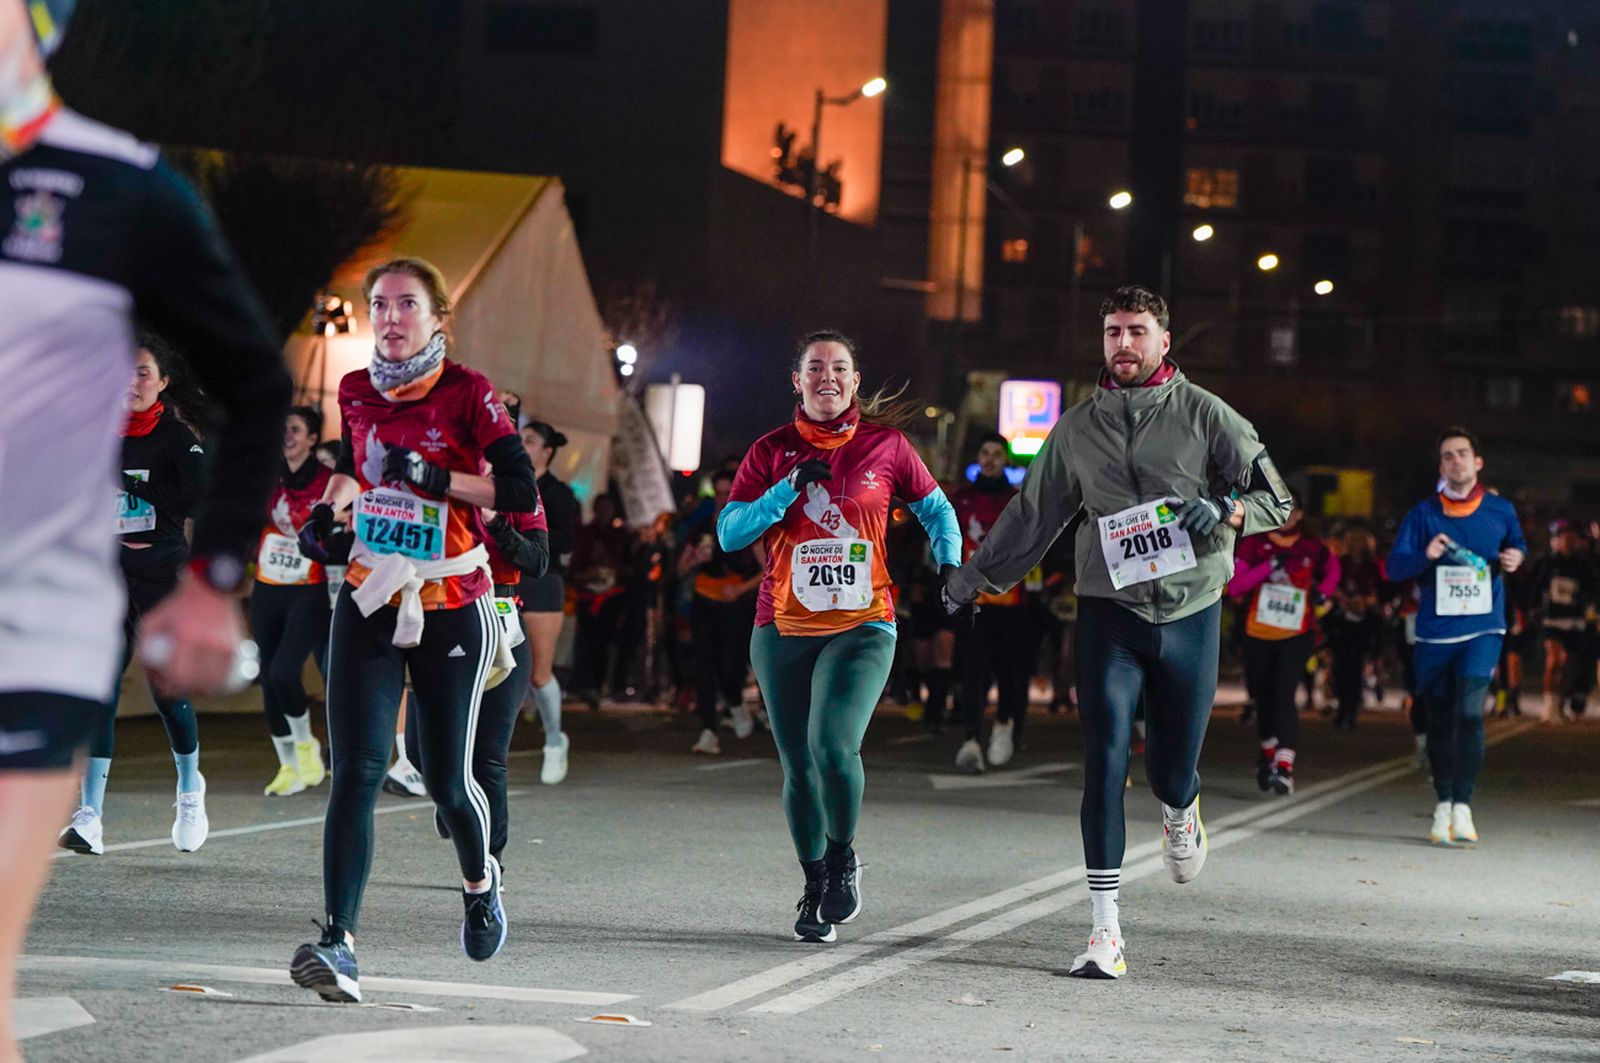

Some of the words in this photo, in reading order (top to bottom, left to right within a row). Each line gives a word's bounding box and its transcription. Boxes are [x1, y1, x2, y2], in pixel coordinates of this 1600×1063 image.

[364, 504, 382, 515] SAN
[374, 497, 402, 507] NOCHE
[404, 502, 415, 510] DE
[821, 510, 840, 530] 43
[1140, 512, 1150, 520] DE
[365, 516, 434, 552] 12451
[1110, 530, 1126, 540] SAN
[1120, 527, 1172, 560] 2018
[809, 547, 833, 555] NOCHE
[834, 546, 843, 554] DE
[801, 556, 817, 564] SAN
[808, 564, 855, 586] 2019
[1449, 585, 1481, 598] 7555
